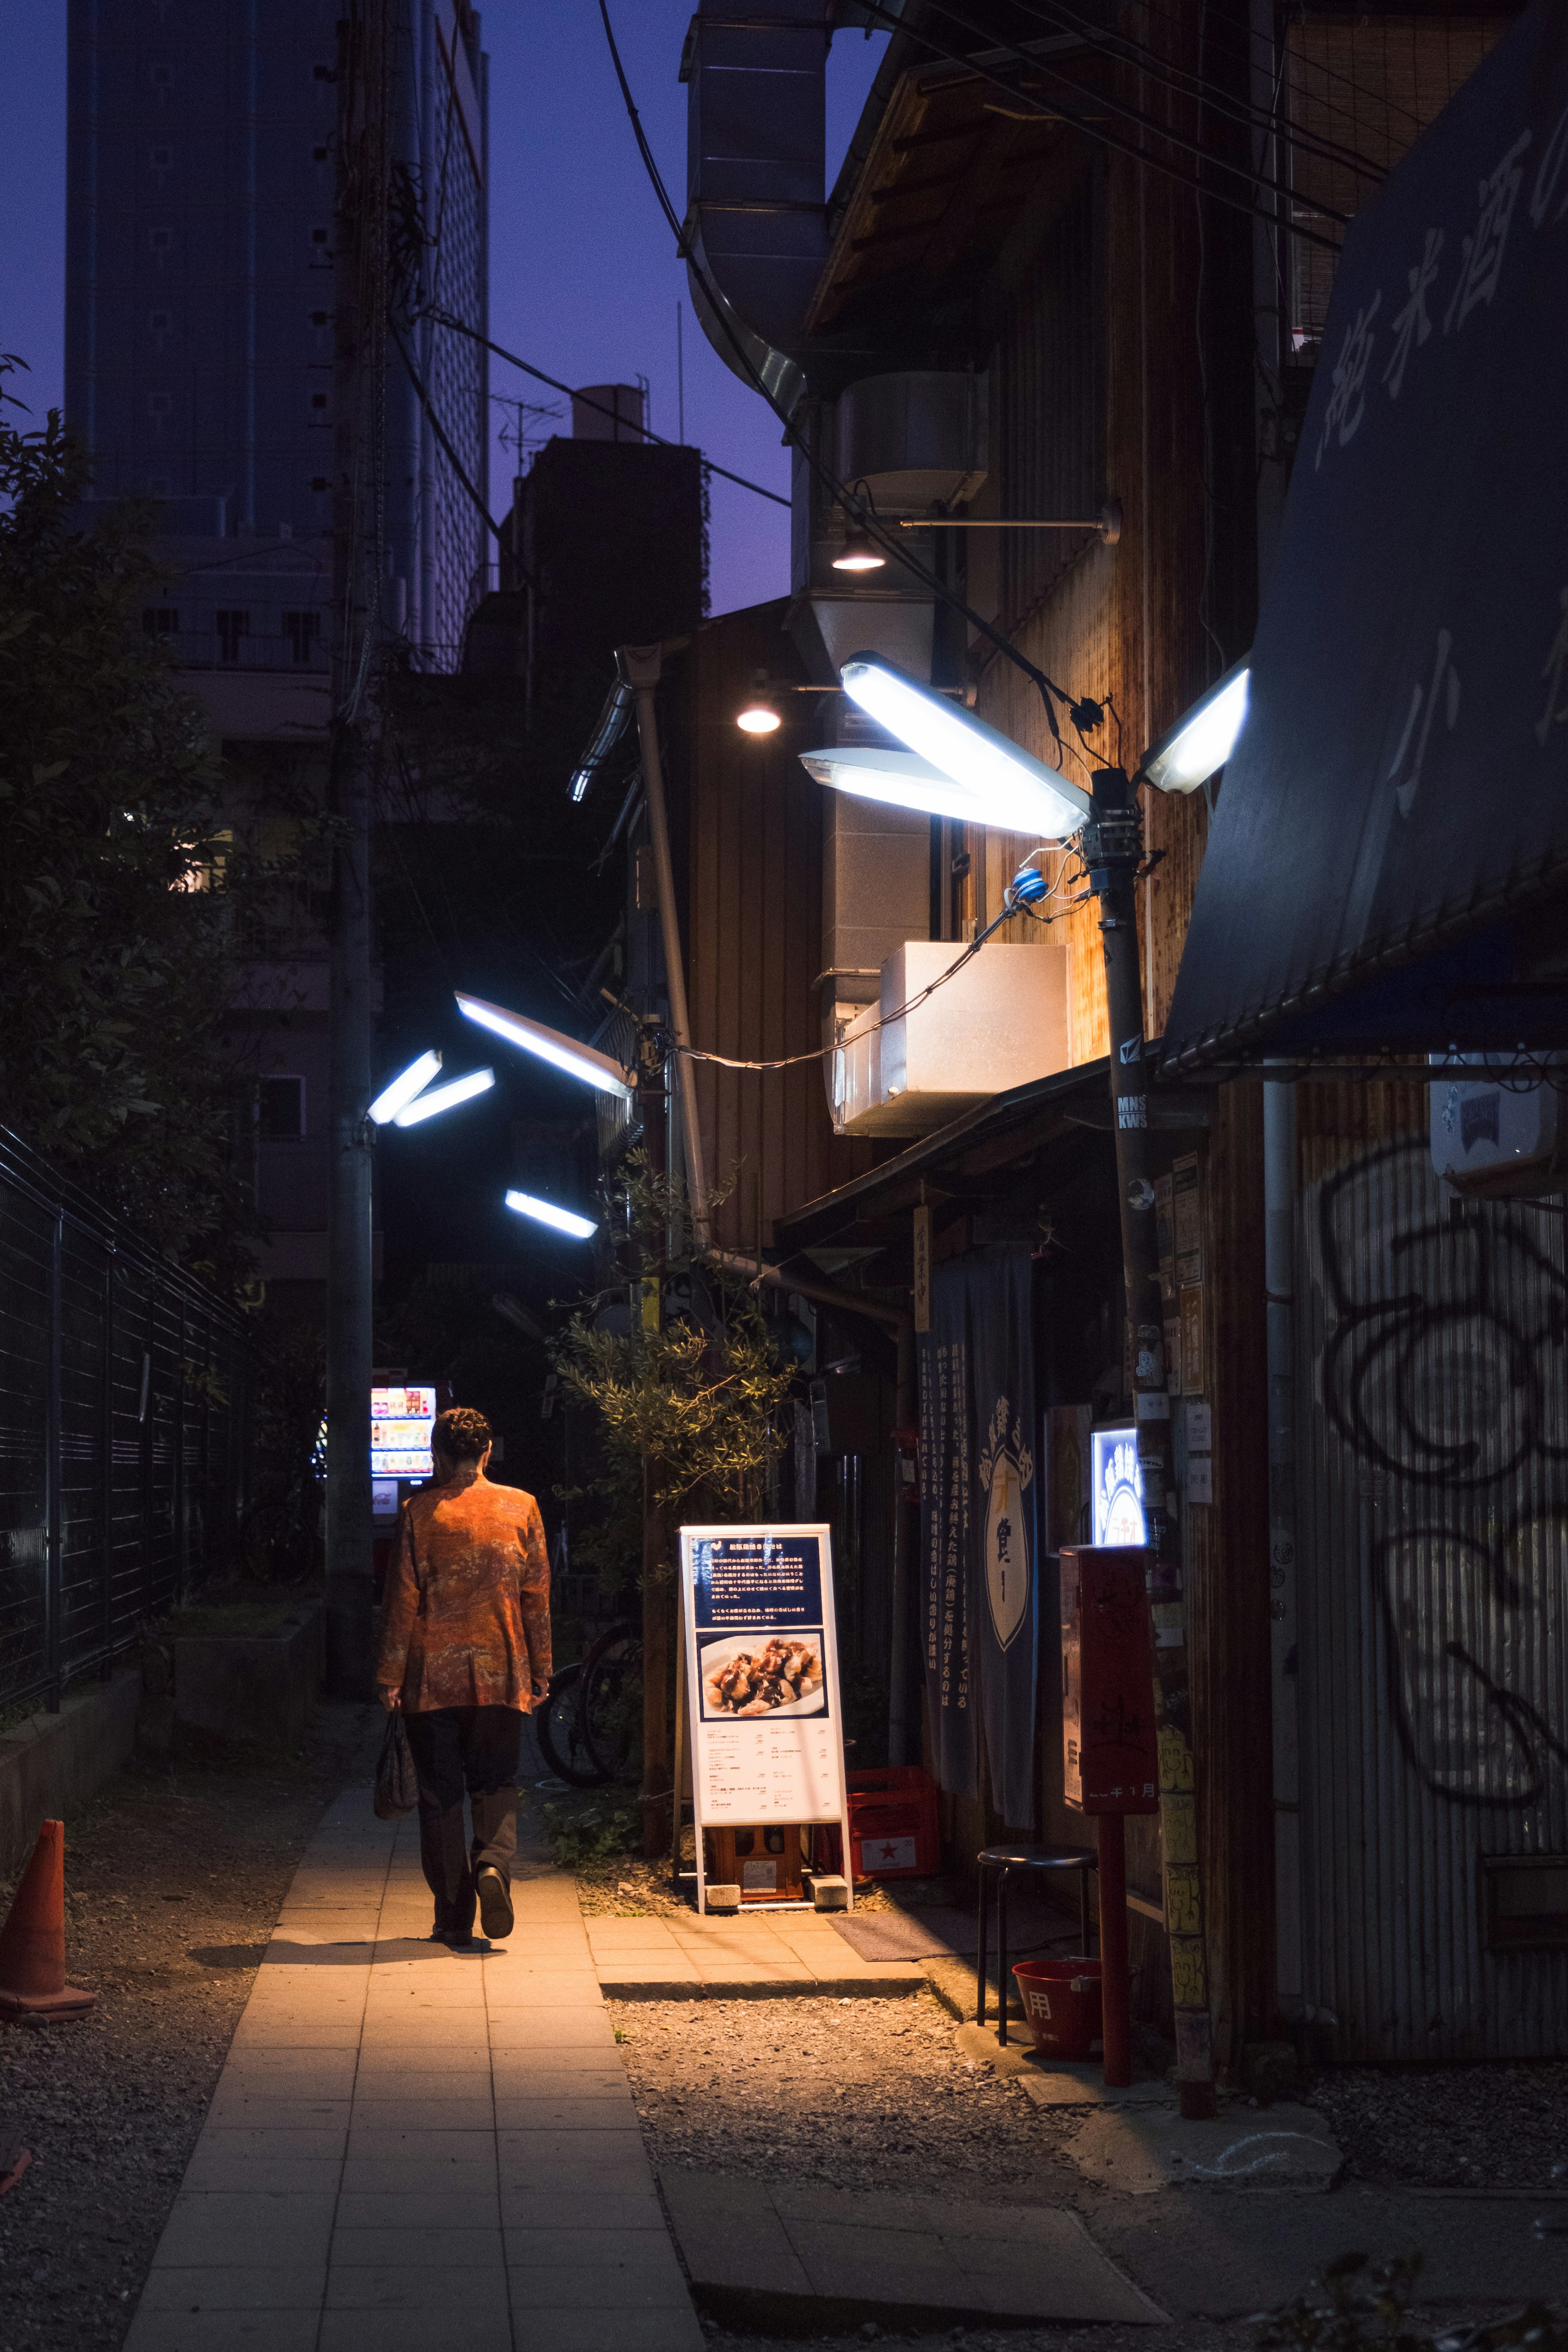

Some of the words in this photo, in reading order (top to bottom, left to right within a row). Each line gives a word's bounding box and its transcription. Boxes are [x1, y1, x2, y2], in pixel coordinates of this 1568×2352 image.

[1117, 1096, 1147, 1112] MNS
[1119, 1114, 1148, 1129] KWS
[1029, 1991, 1051, 2020] 用
